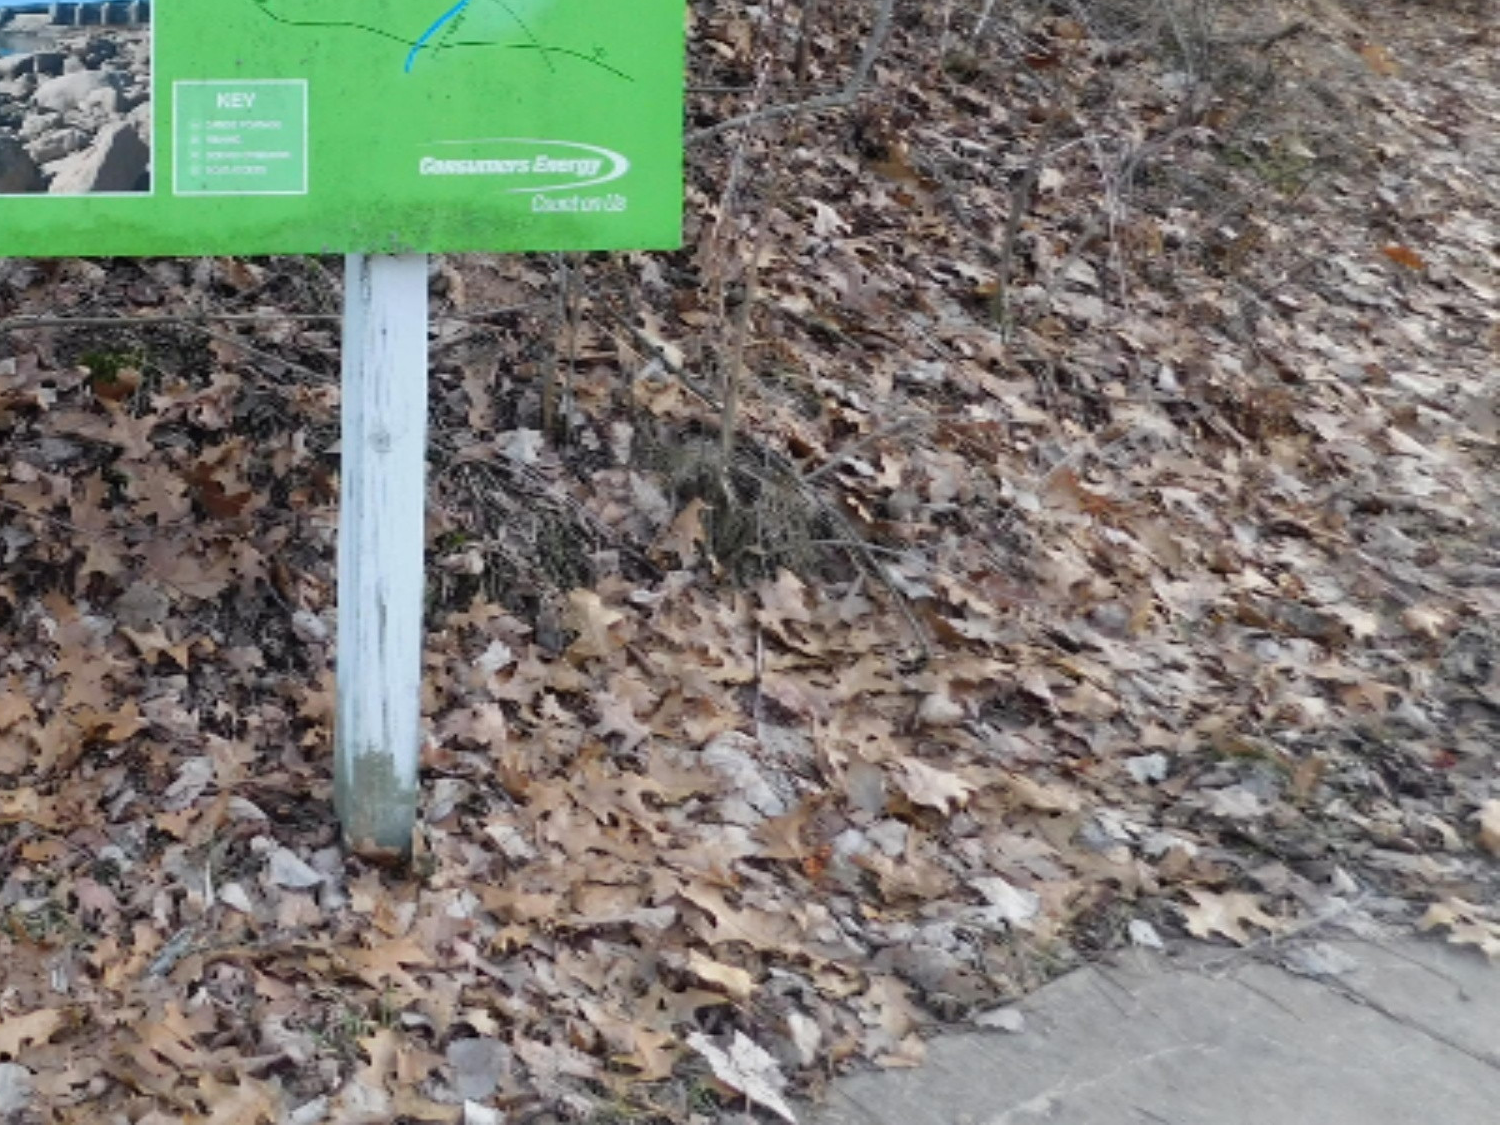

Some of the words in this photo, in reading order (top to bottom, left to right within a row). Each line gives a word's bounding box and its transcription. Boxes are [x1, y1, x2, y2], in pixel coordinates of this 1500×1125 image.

[216, 91, 256, 108] KEY
[419, 157, 530, 175] Consumers
[532, 155, 603, 177] Energy
[531, 194, 579, 213] Count
[581, 197, 602, 212] on
[603, 193, 628, 213] Us
